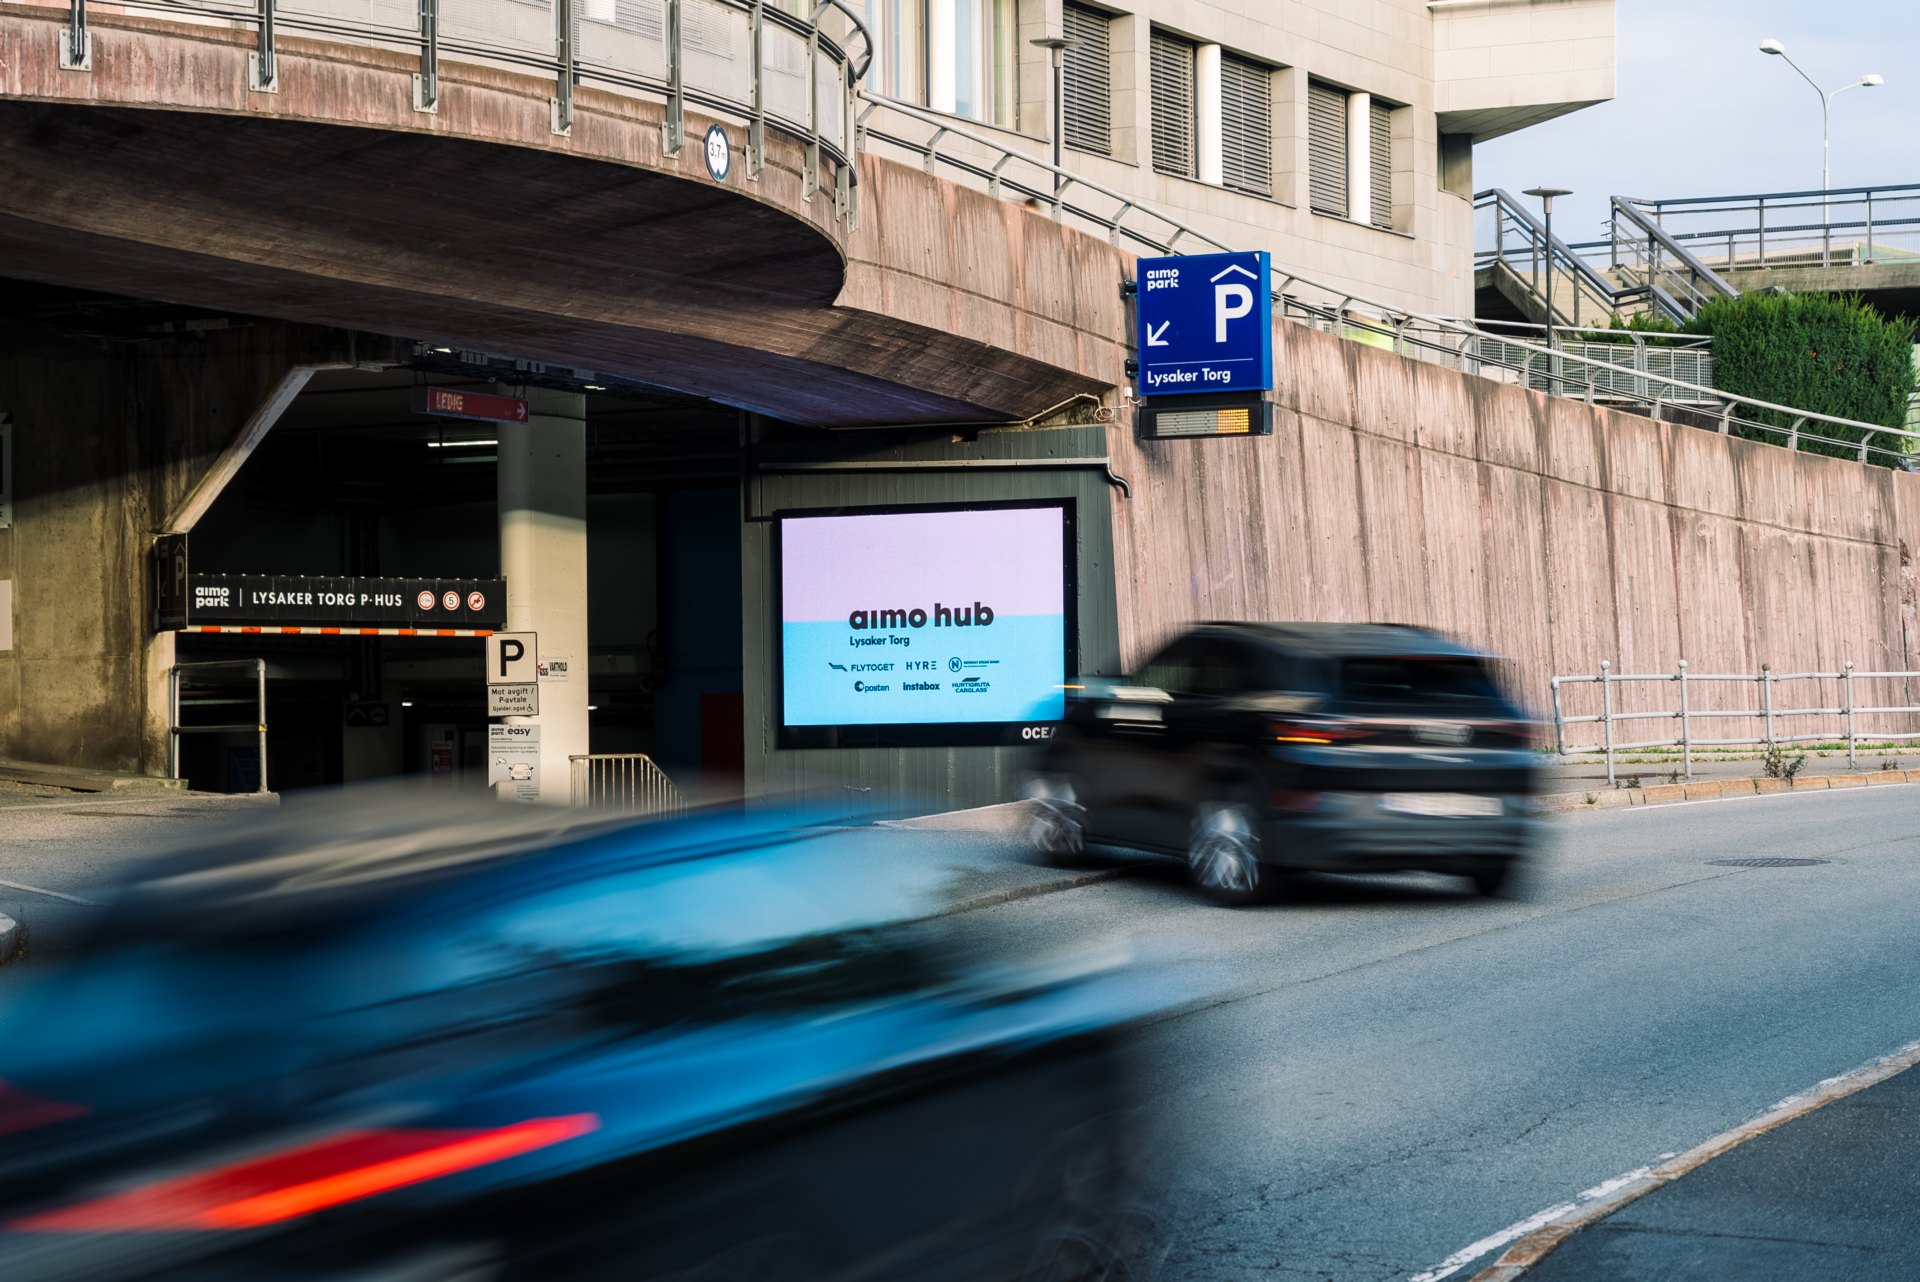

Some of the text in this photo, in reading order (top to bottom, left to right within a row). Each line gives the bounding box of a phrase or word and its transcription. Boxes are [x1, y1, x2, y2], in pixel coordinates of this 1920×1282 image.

[1146, 268, 1179, 279] aimo
[1147, 278, 1179, 291] park
[1215, 283, 1253, 342] P
[1147, 368, 1231, 386] Lysaker Torg
[436, 392, 463, 411] LEDIG
[195, 586, 230, 597] aimo
[196, 596, 229, 608] park
[252, 591, 313, 605] LYSAKER
[317, 592, 356, 606] TORG
[448, 596, 454, 605] 5
[850, 602, 994, 630] aimo hub
[850, 634, 910, 648] Lysaker Torg
[500, 639, 525, 676] P
[851, 663, 895, 672] FLYTOGET
[906, 661, 937, 670] HYRE
[864, 684, 890, 693] posten
[903, 681, 940, 690] instabox
[508, 688, 528, 696] avgift
[508, 727, 531, 736] easy
